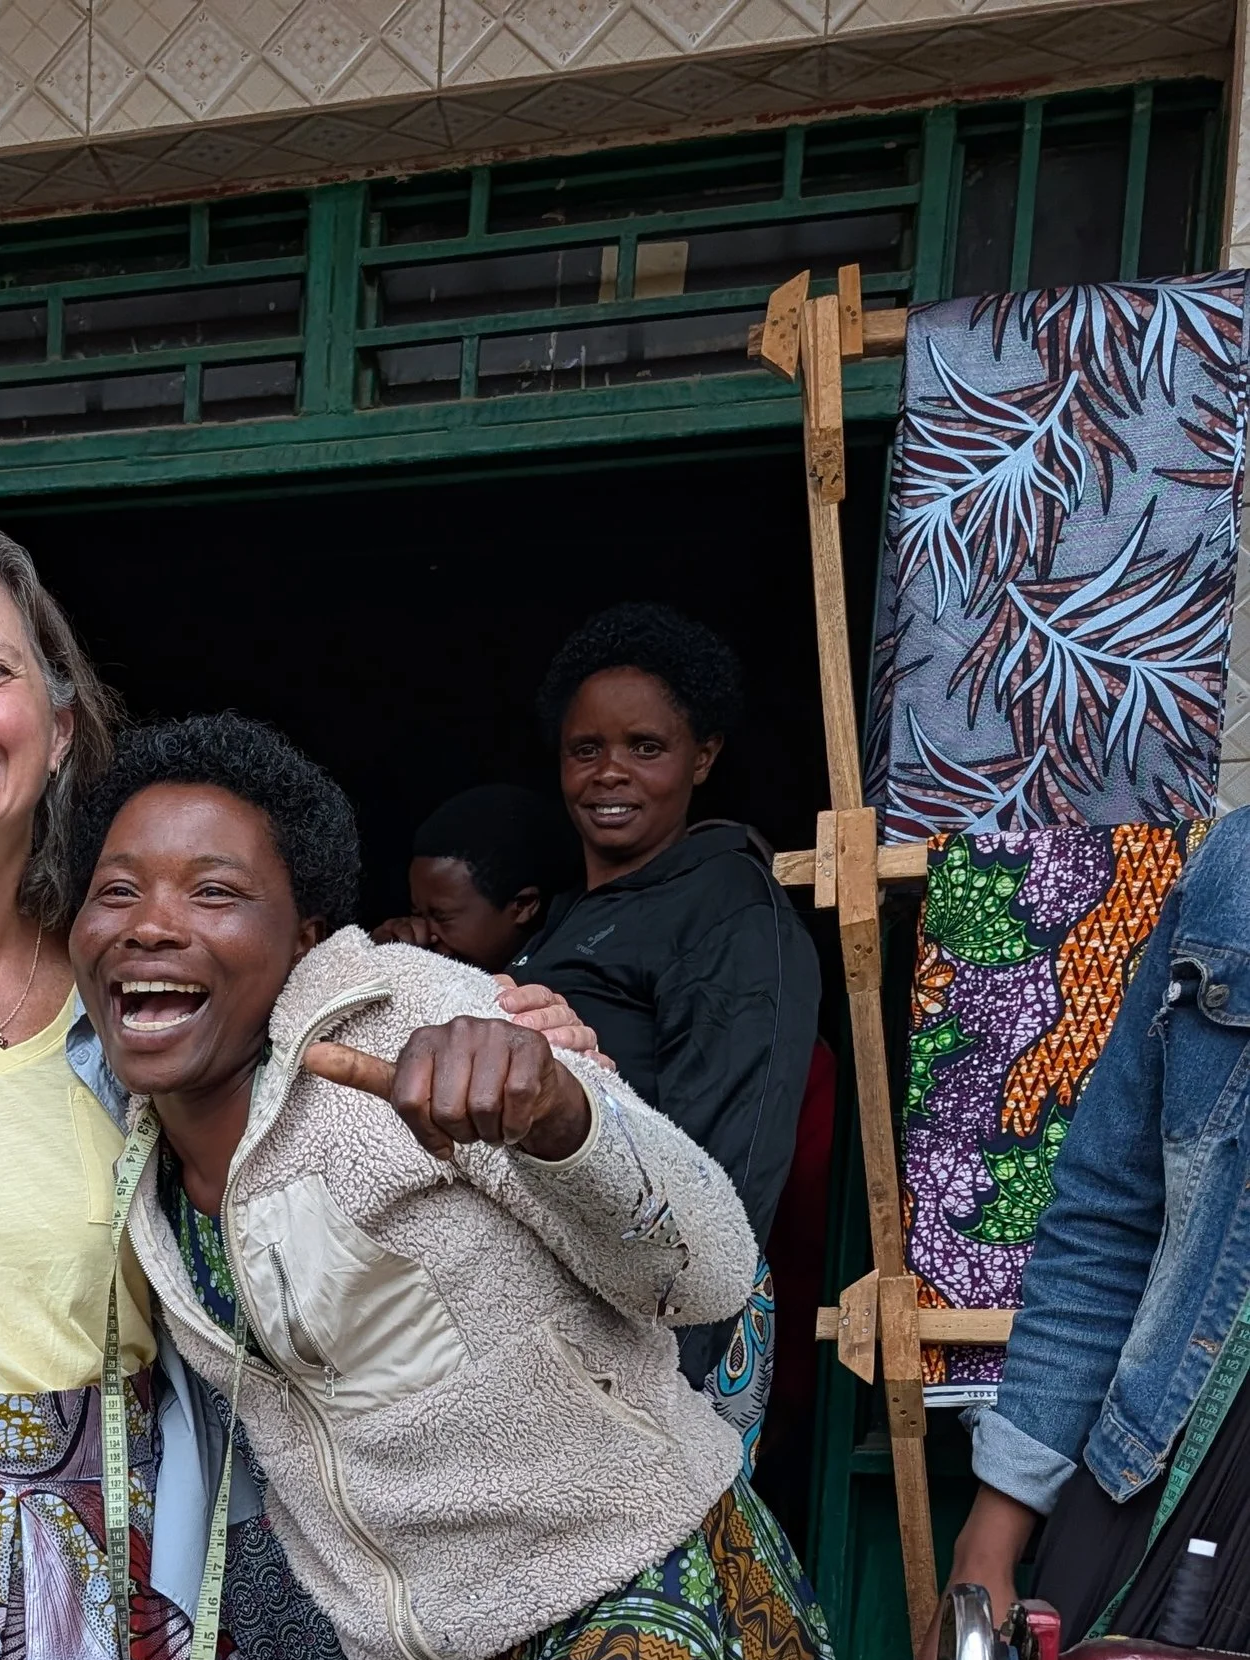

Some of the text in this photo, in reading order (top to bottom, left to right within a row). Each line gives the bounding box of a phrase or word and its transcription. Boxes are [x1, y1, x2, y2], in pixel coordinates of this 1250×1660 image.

[117, 1176, 129, 1196] 45
[1226, 1359, 1239, 1370] 123
[1219, 1374, 1233, 1384] 124
[108, 1400, 118, 1408] 131
[108, 1413, 119, 1421] 132
[1199, 1417, 1213, 1428] 127
[110, 1453, 121, 1461] 135
[113, 1546, 124, 1554] 142
[207, 1597, 219, 1616] 16
[203, 1631, 215, 1651] 15
